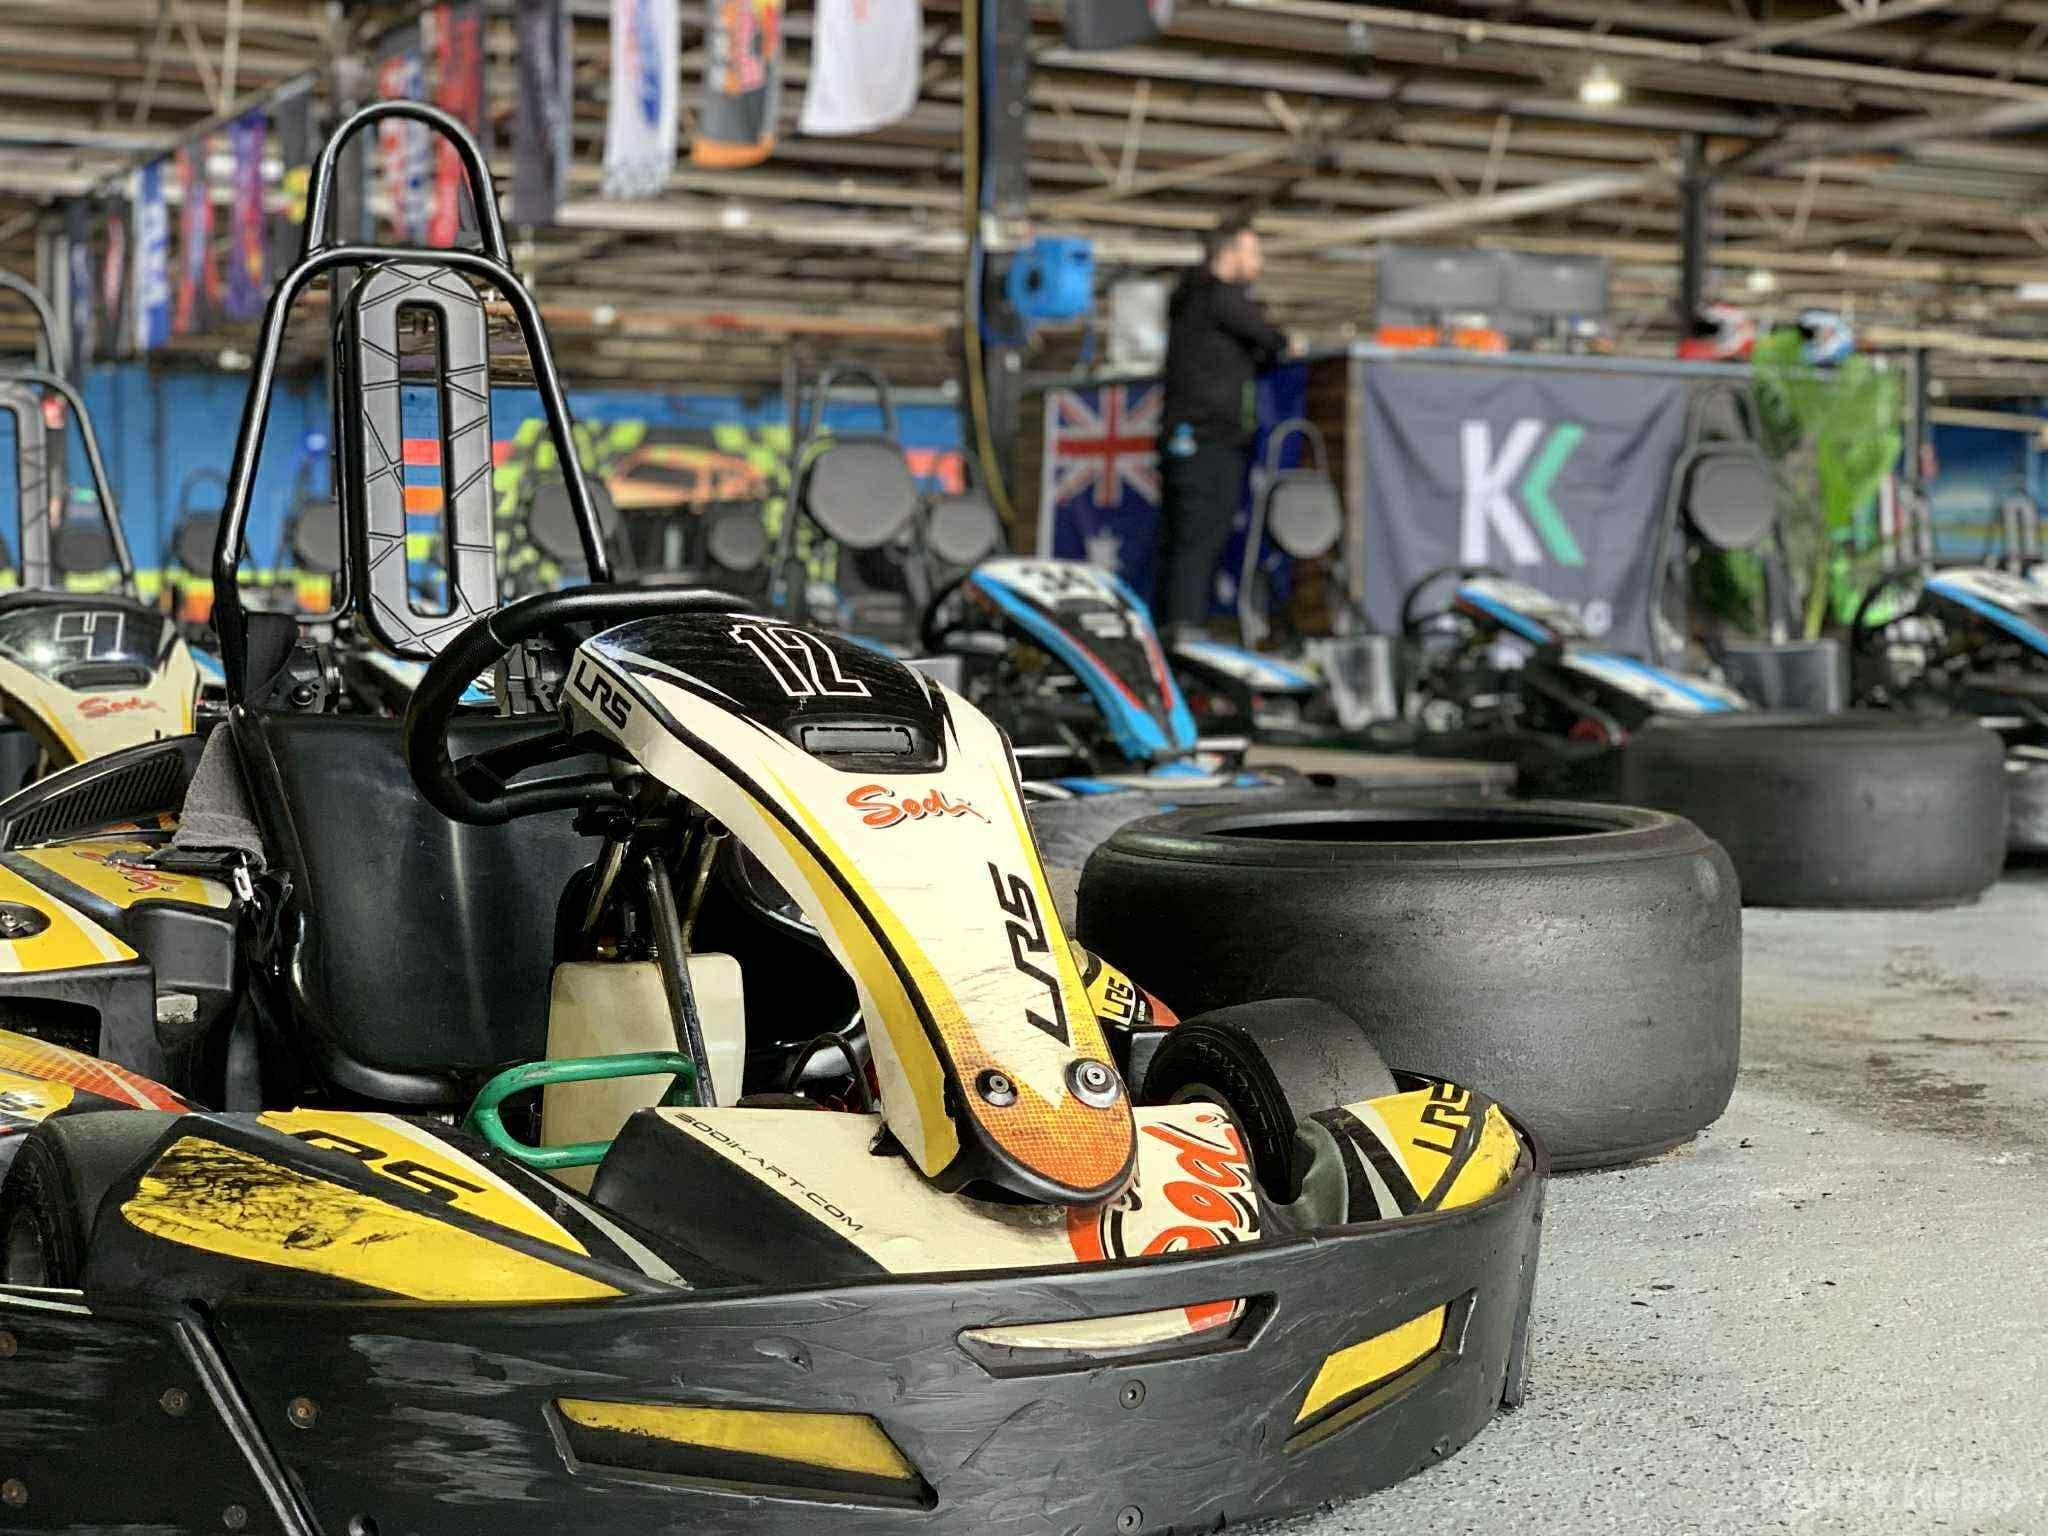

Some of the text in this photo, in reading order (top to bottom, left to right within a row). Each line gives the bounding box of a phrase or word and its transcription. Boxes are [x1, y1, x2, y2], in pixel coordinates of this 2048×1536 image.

[55, 610, 125, 662] 4
[728, 624, 873, 697] 12
[573, 660, 632, 730] LRS
[846, 784, 992, 830] Sodi
[987, 861, 1072, 1048] LRS
[1102, 975, 1135, 1019] LRS
